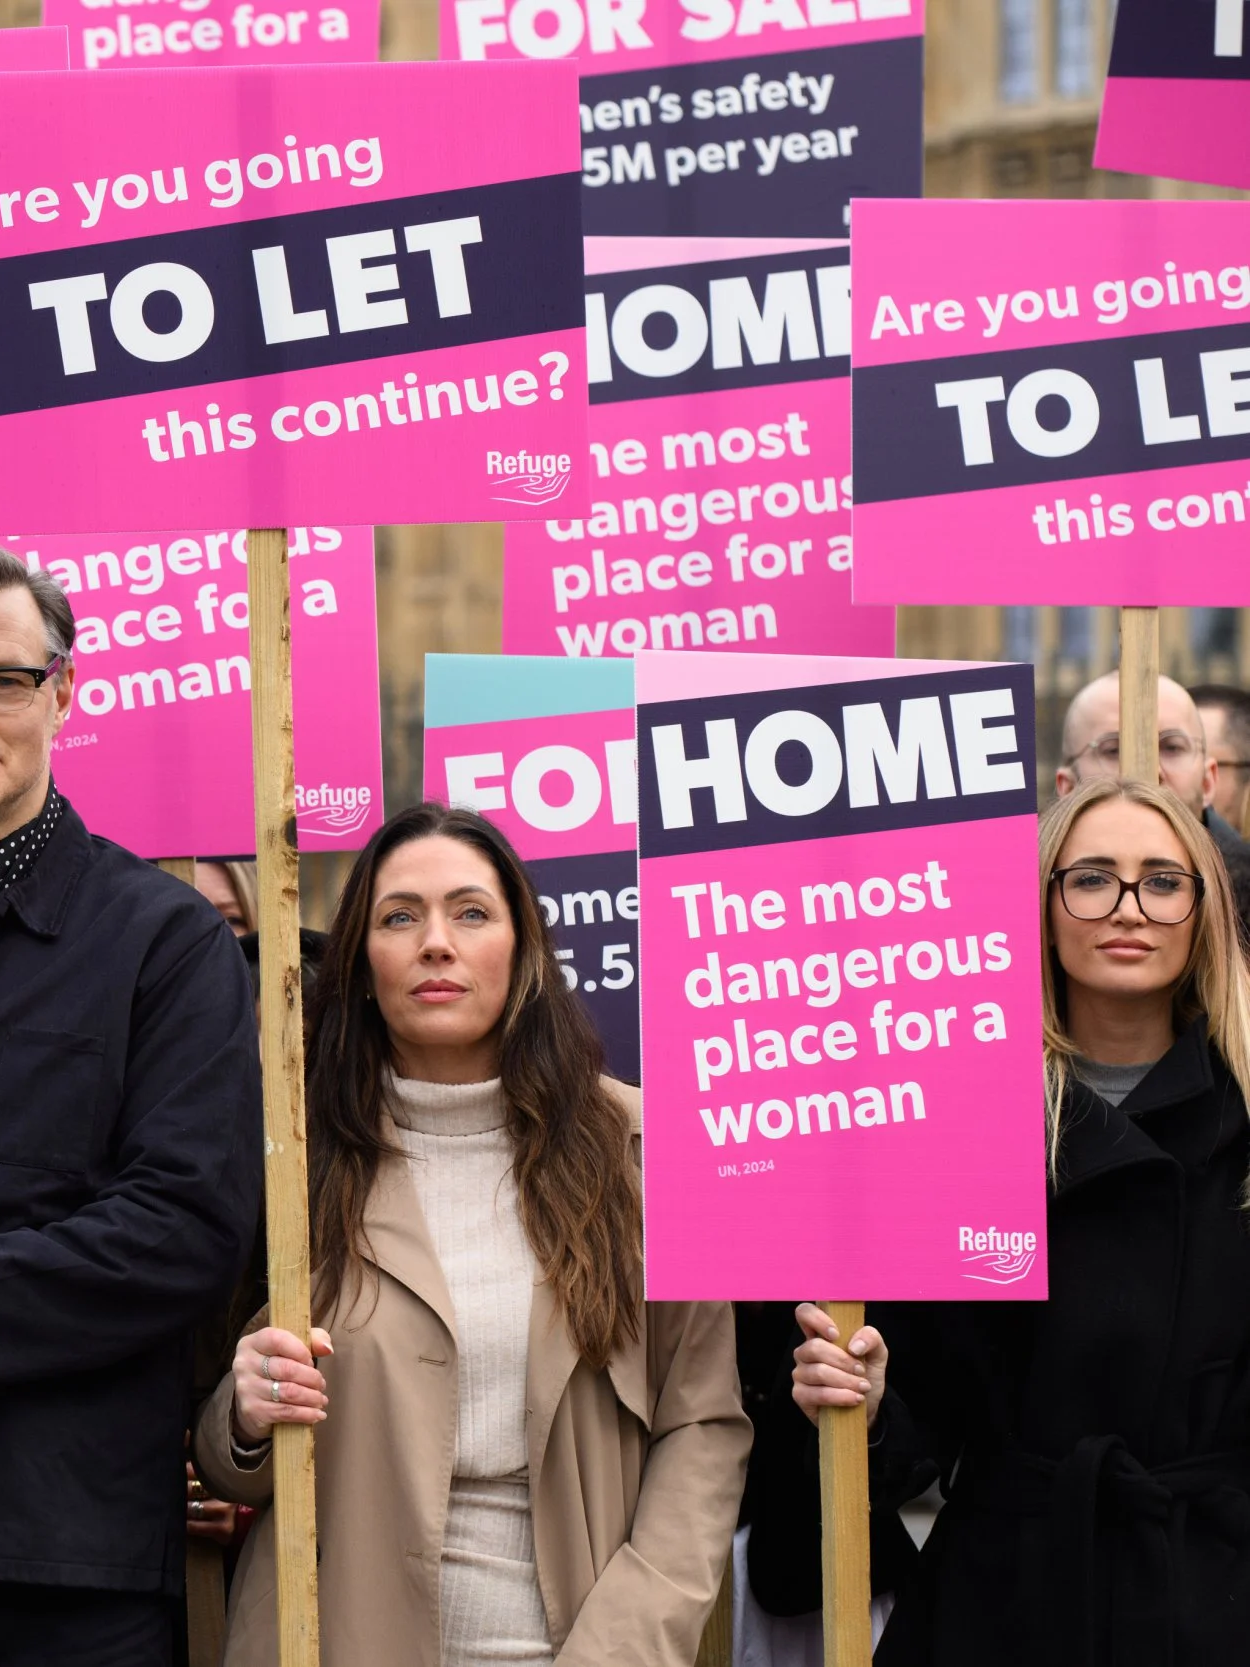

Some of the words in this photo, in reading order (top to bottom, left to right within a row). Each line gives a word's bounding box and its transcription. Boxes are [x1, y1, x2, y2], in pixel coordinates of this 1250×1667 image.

[83, 14, 223, 69] place
[232, 4, 308, 47] for
[318, 8, 350, 41] a
[692, 72, 834, 119] safety
[73, 165, 188, 228] you
[203, 135, 383, 209] going
[665, 139, 745, 186] per
[753, 126, 859, 176] year
[28, 261, 215, 376] TO
[251, 215, 482, 345] LET
[870, 296, 965, 339] Are
[977, 286, 1079, 337] you
[1093, 262, 1250, 324] going
[142, 403, 256, 463] this
[270, 351, 569, 441] continue?
[935, 368, 1099, 466] TO
[486, 450, 570, 477] Refuge
[662, 413, 810, 470] most
[1032, 494, 1134, 545] this
[302, 577, 338, 617] a
[551, 549, 712, 613] place
[725, 533, 812, 582] for
[556, 603, 778, 657] woman
[65, 733, 98, 748] 2024
[651, 688, 1025, 830] HOME
[294, 783, 371, 810] Refuge
[672, 881, 786, 940] The
[800, 860, 951, 925] most
[684, 930, 1011, 1009] dangerous
[693, 1017, 857, 1092] place
[870, 1001, 956, 1055] for
[972, 1002, 1007, 1043] a
[699, 1081, 926, 1148] woman
[718, 1165, 741, 1177] UN,
[743, 1160, 775, 1174] 2024
[959, 1226, 1037, 1256] Refuge
